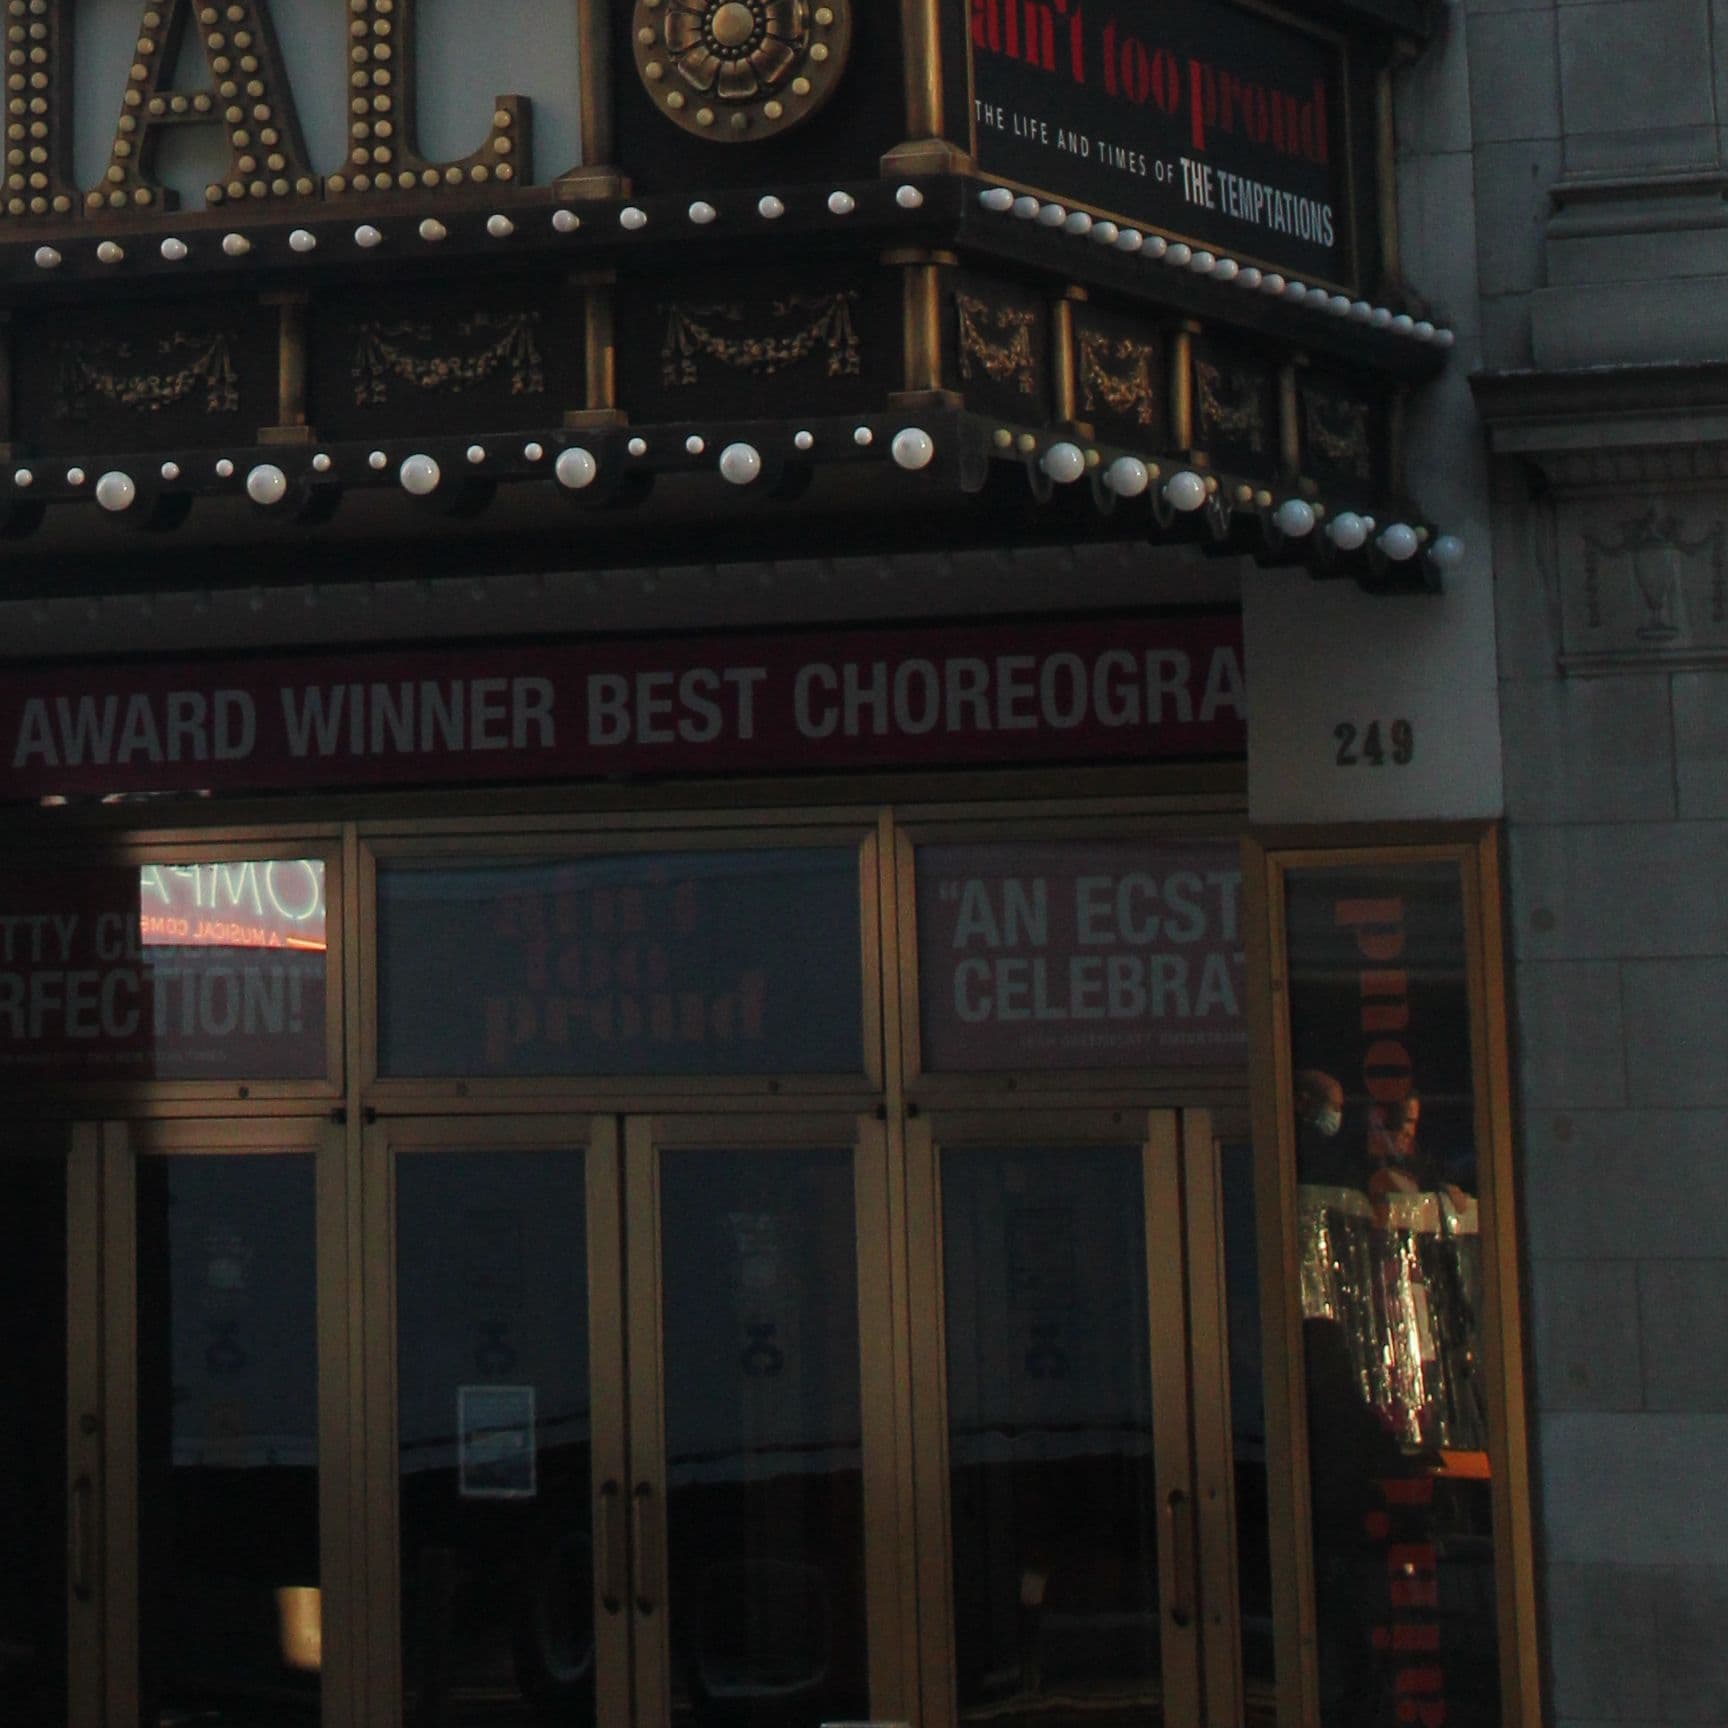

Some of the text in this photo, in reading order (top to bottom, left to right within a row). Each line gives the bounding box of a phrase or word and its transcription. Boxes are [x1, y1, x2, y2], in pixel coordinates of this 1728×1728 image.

[1103, 18, 1180, 113] too
[1189, 57, 1328, 166] proud
[974, 100, 1334, 248] THE LIFE AND TIMES OF THE TEMPTATIONS
[12, 688, 257, 770] AWARD
[279, 675, 557, 758] WINNER
[587, 666, 768, 746] BEST
[1333, 717, 1415, 767] 249
[953, 951, 1247, 1023] CELEBRA
